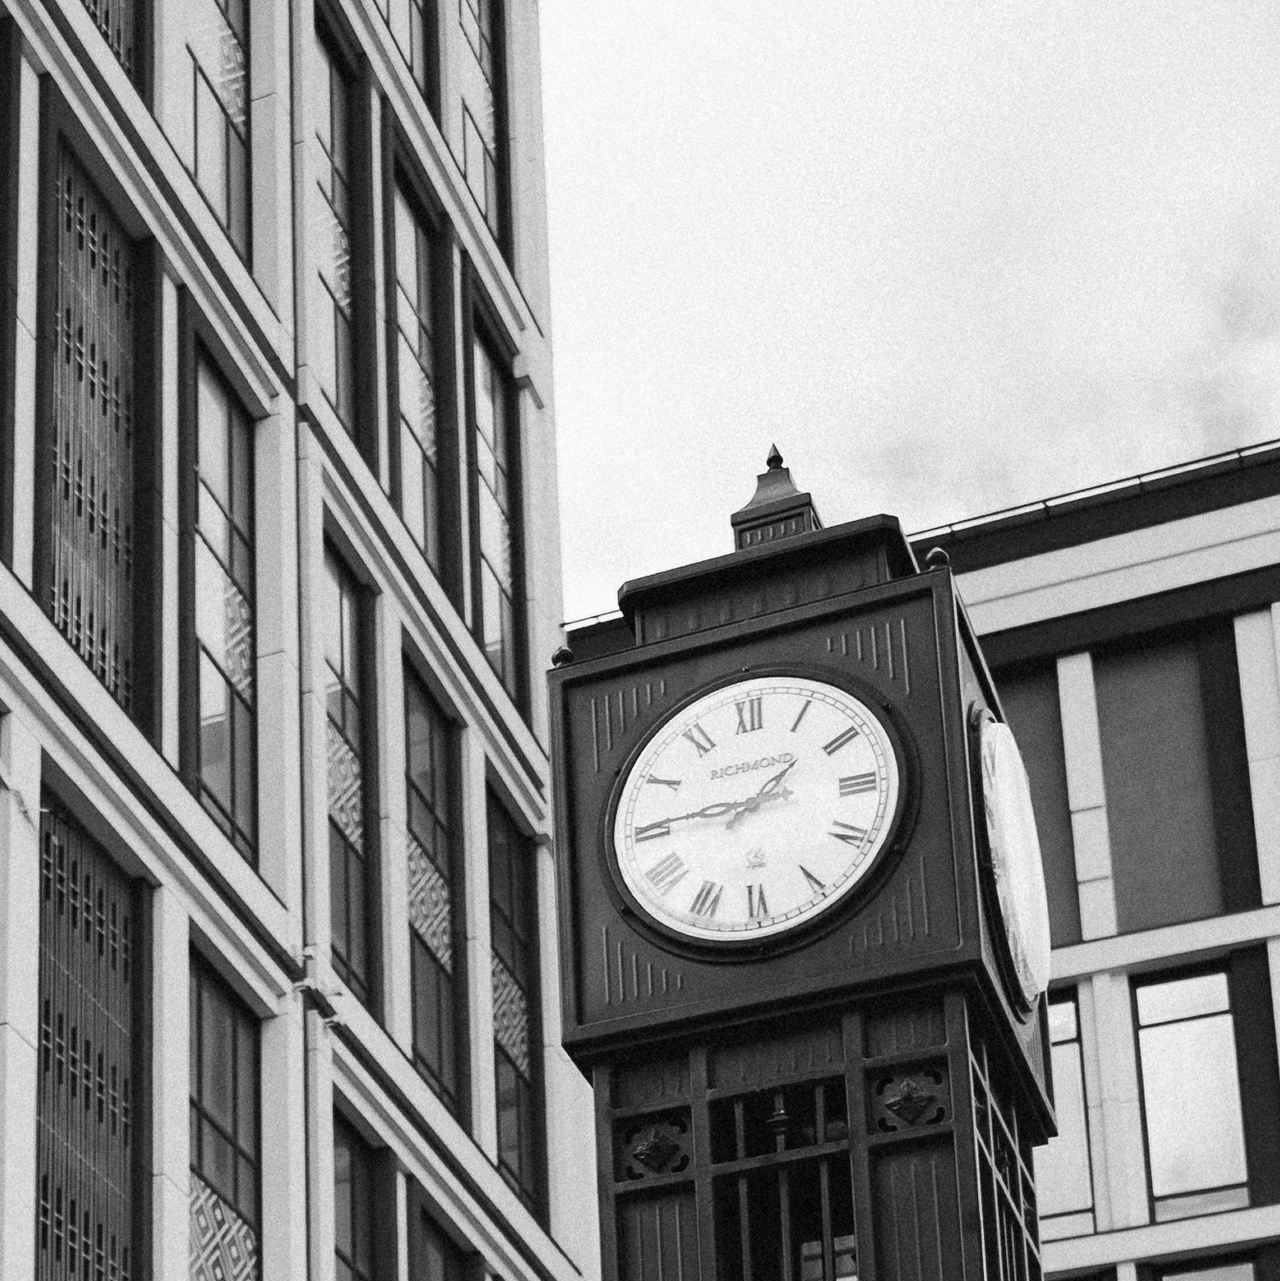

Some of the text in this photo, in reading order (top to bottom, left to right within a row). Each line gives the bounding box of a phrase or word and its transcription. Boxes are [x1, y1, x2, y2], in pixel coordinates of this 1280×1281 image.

[735, 697, 763, 735] XII
[682, 722, 716, 758] XI
[822, 725, 860, 757] II
[710, 752, 793, 780] RICHMOND
[645, 774, 682, 791] X
[838, 771, 877, 798] III
[827, 819, 868, 849] IV
[645, 851, 689, 897] VIII
[798, 864, 826, 894] V
[689, 880, 724, 918] VII
[746, 883, 769, 918] VI
